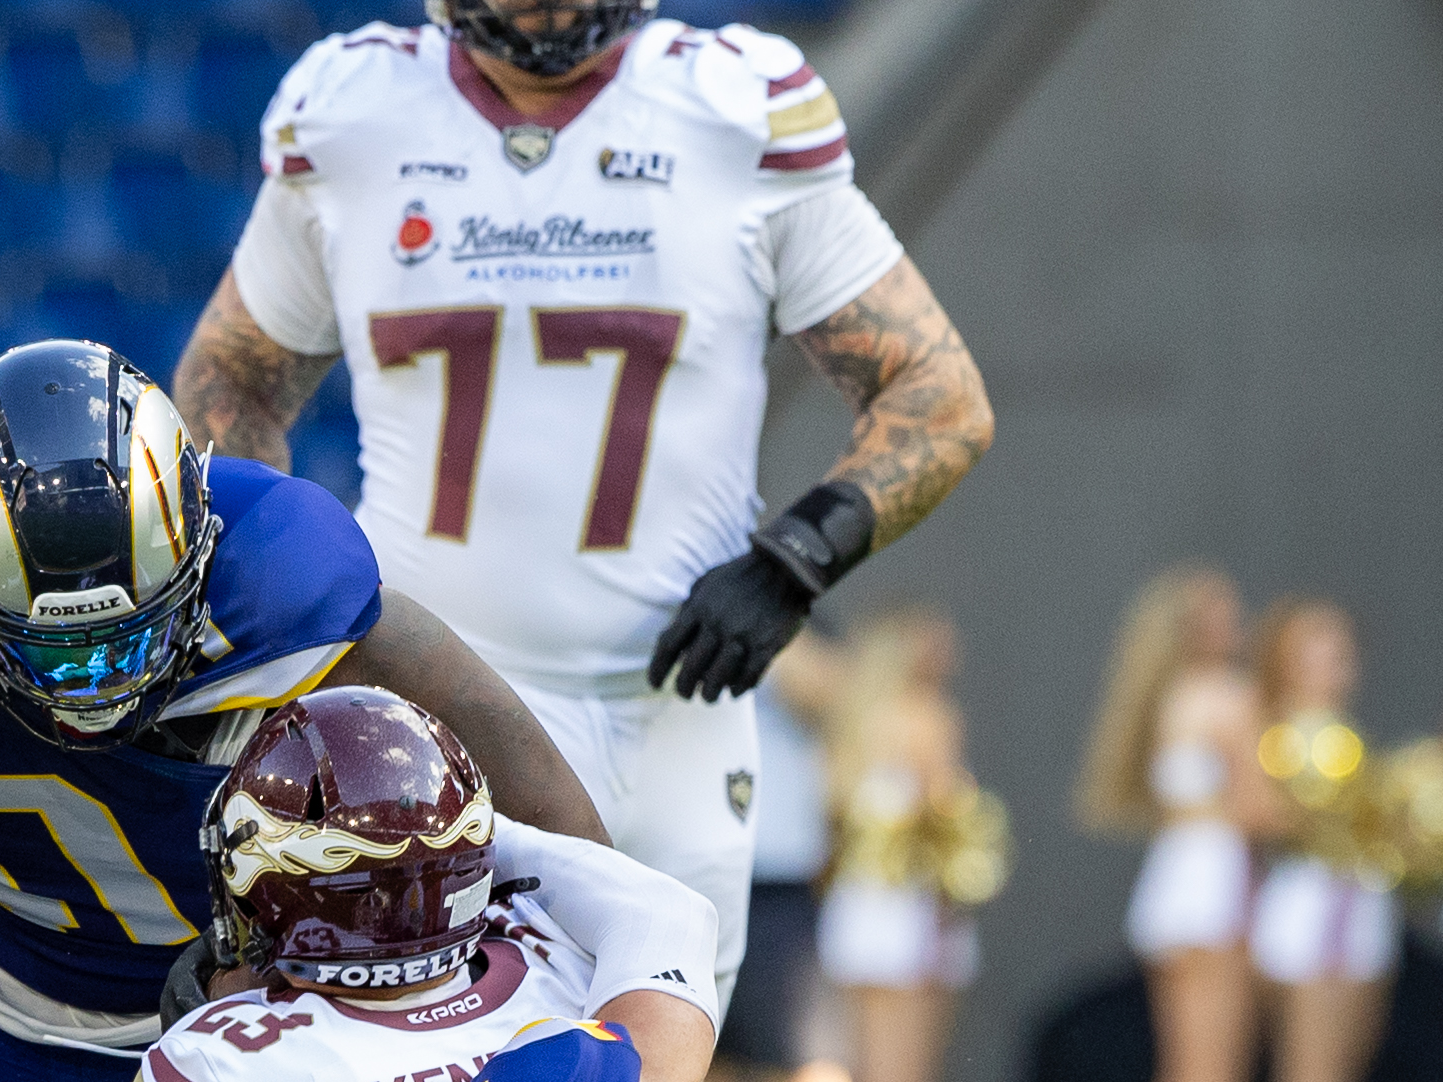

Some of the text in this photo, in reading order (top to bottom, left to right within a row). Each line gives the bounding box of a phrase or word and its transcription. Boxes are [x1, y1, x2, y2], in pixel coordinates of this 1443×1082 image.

[368, 305, 688, 553] 77
[38, 596, 121, 617] FORELLE
[315, 934, 482, 988] FORELLE
